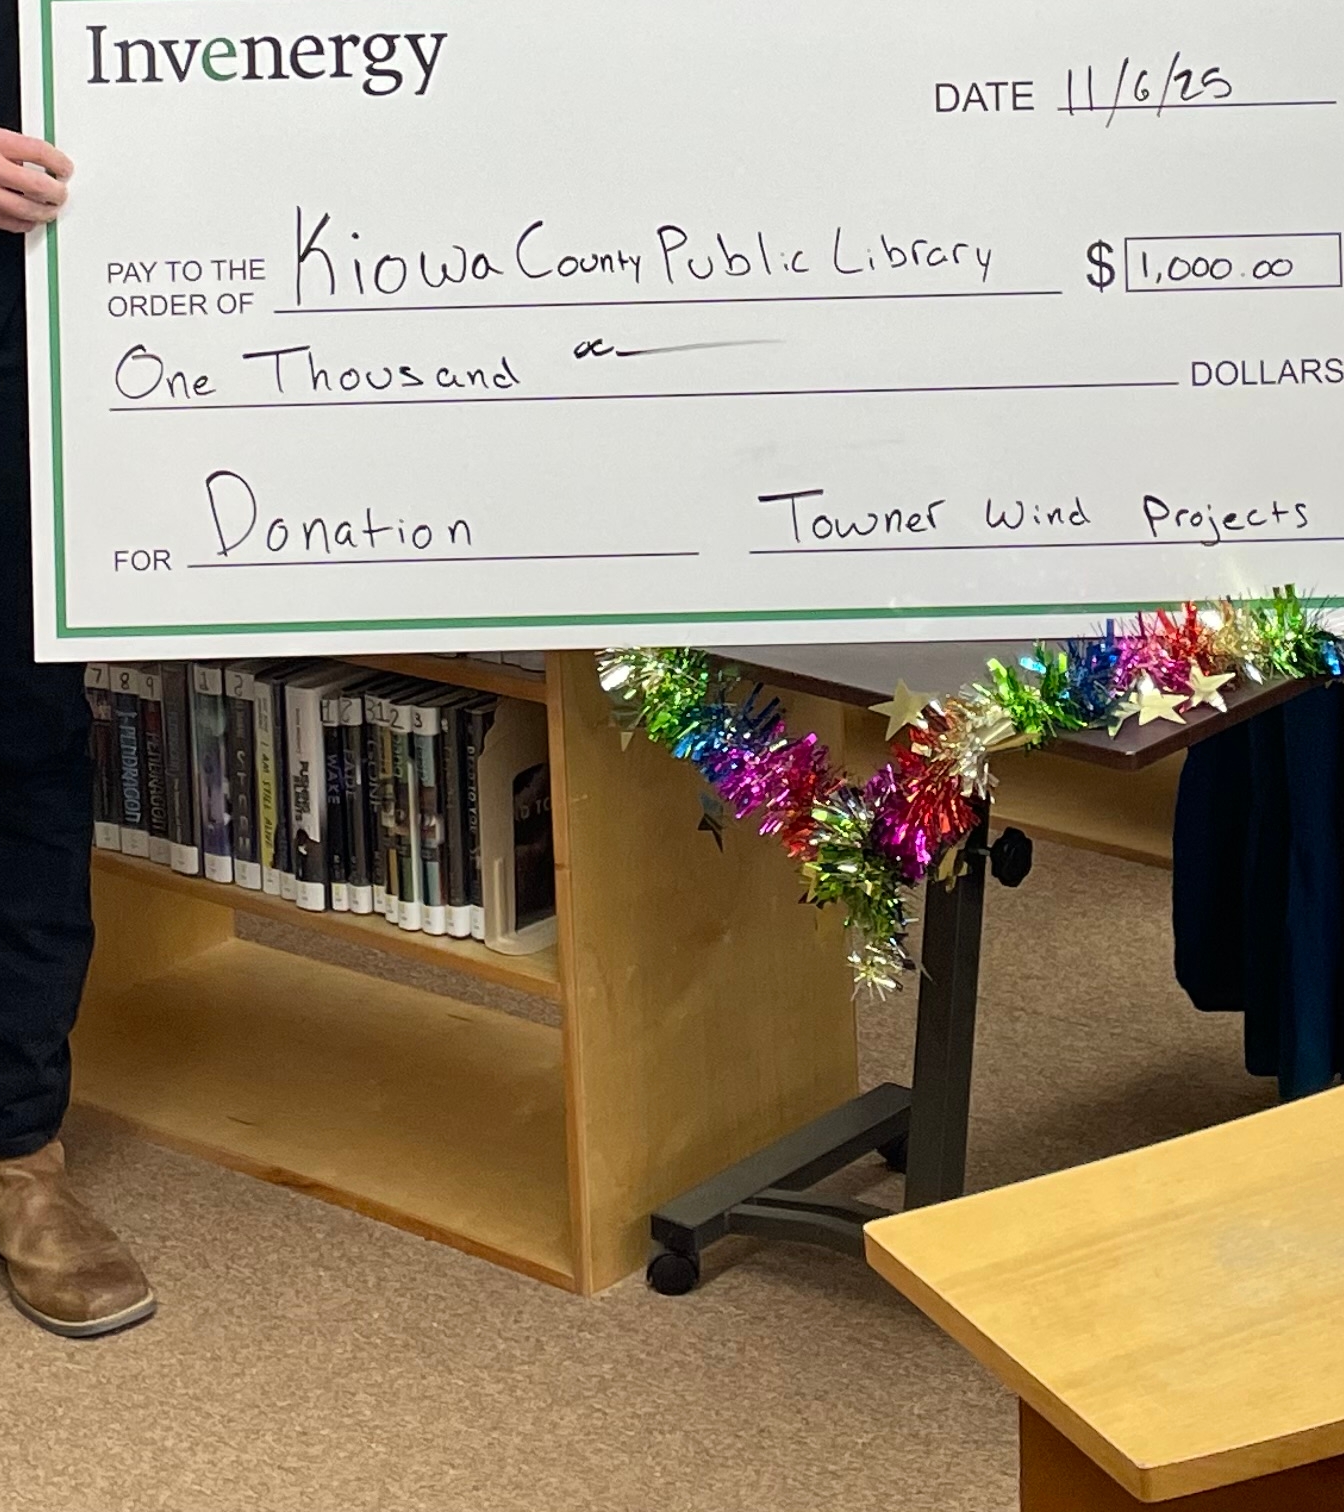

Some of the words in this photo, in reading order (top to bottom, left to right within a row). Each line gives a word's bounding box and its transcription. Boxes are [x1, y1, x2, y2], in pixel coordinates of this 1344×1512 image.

[86, 24, 449, 96] Invenergy
[934, 81, 1035, 113] DATE
[1064, 50, 1233, 128] 11/6/25
[107, 261, 152, 285] PAY
[165, 260, 202, 283] TO
[210, 259, 266, 282] THE
[296, 205, 504, 307] Kiowa
[516, 219, 642, 286] County
[656, 225, 810, 285] Public
[833, 226, 993, 284] Library
[1086, 239, 1116, 293] $
[1140, 251, 1294, 286] 1,000.00
[107, 294, 209, 318] ORDER
[215, 293, 255, 315] OF
[114, 344, 217, 401] One
[242, 344, 520, 394] Thousand
[1191, 358, 1344, 386] DOLLARS
[114, 549, 172, 571] FOR
[204, 469, 472, 557] Donation
[758, 488, 946, 542] Towner
[986, 495, 1091, 529] Wind
[1145, 493, 1308, 547] Projects
[119, 726, 141, 823] PENDRAGON
[261, 753, 270, 774] AM
[327, 754, 340, 805] WAKE
[262, 780, 273, 811] STILL
[264, 818, 273, 849] ALIVE
